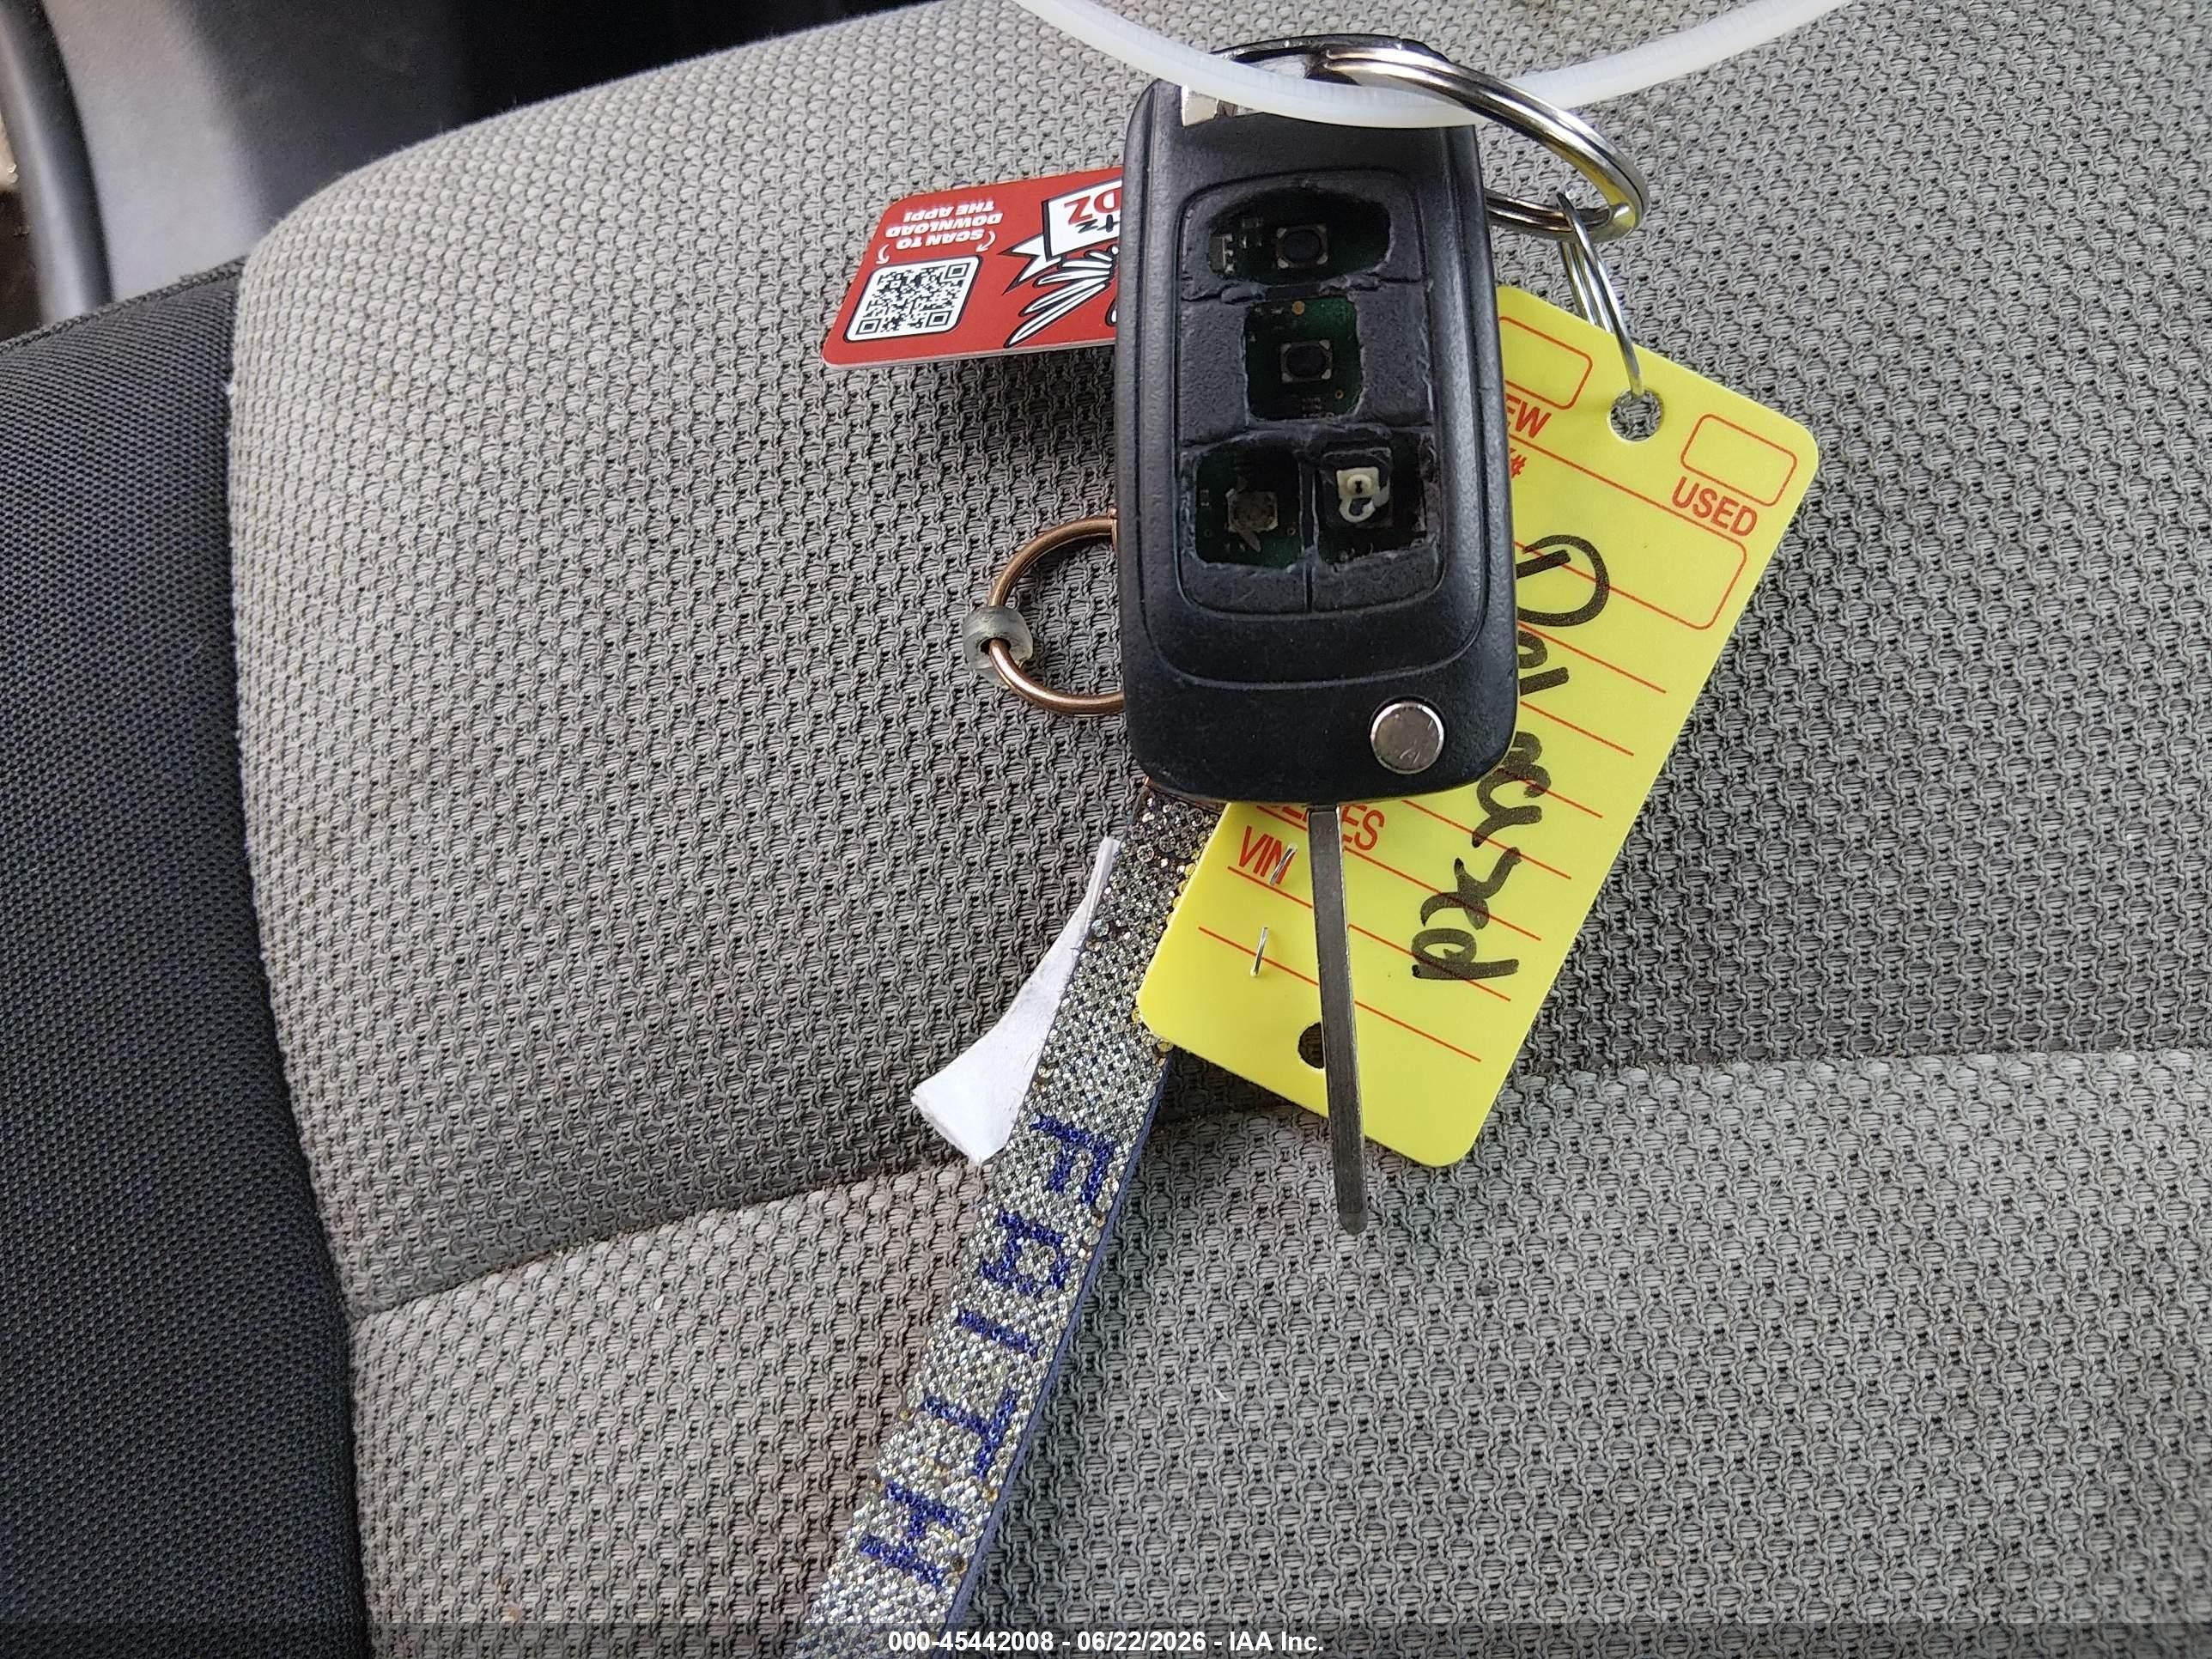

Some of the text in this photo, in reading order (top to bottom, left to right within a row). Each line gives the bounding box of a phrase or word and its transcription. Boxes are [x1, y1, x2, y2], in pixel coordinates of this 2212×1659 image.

[902, 200, 994, 223] THE APP!
[885, 212, 1004, 238] DOWNLOAD
[896, 228, 985, 250] SCAN TO
[1671, 476, 1759, 538] USED
[1238, 824, 1296, 884] VIN
